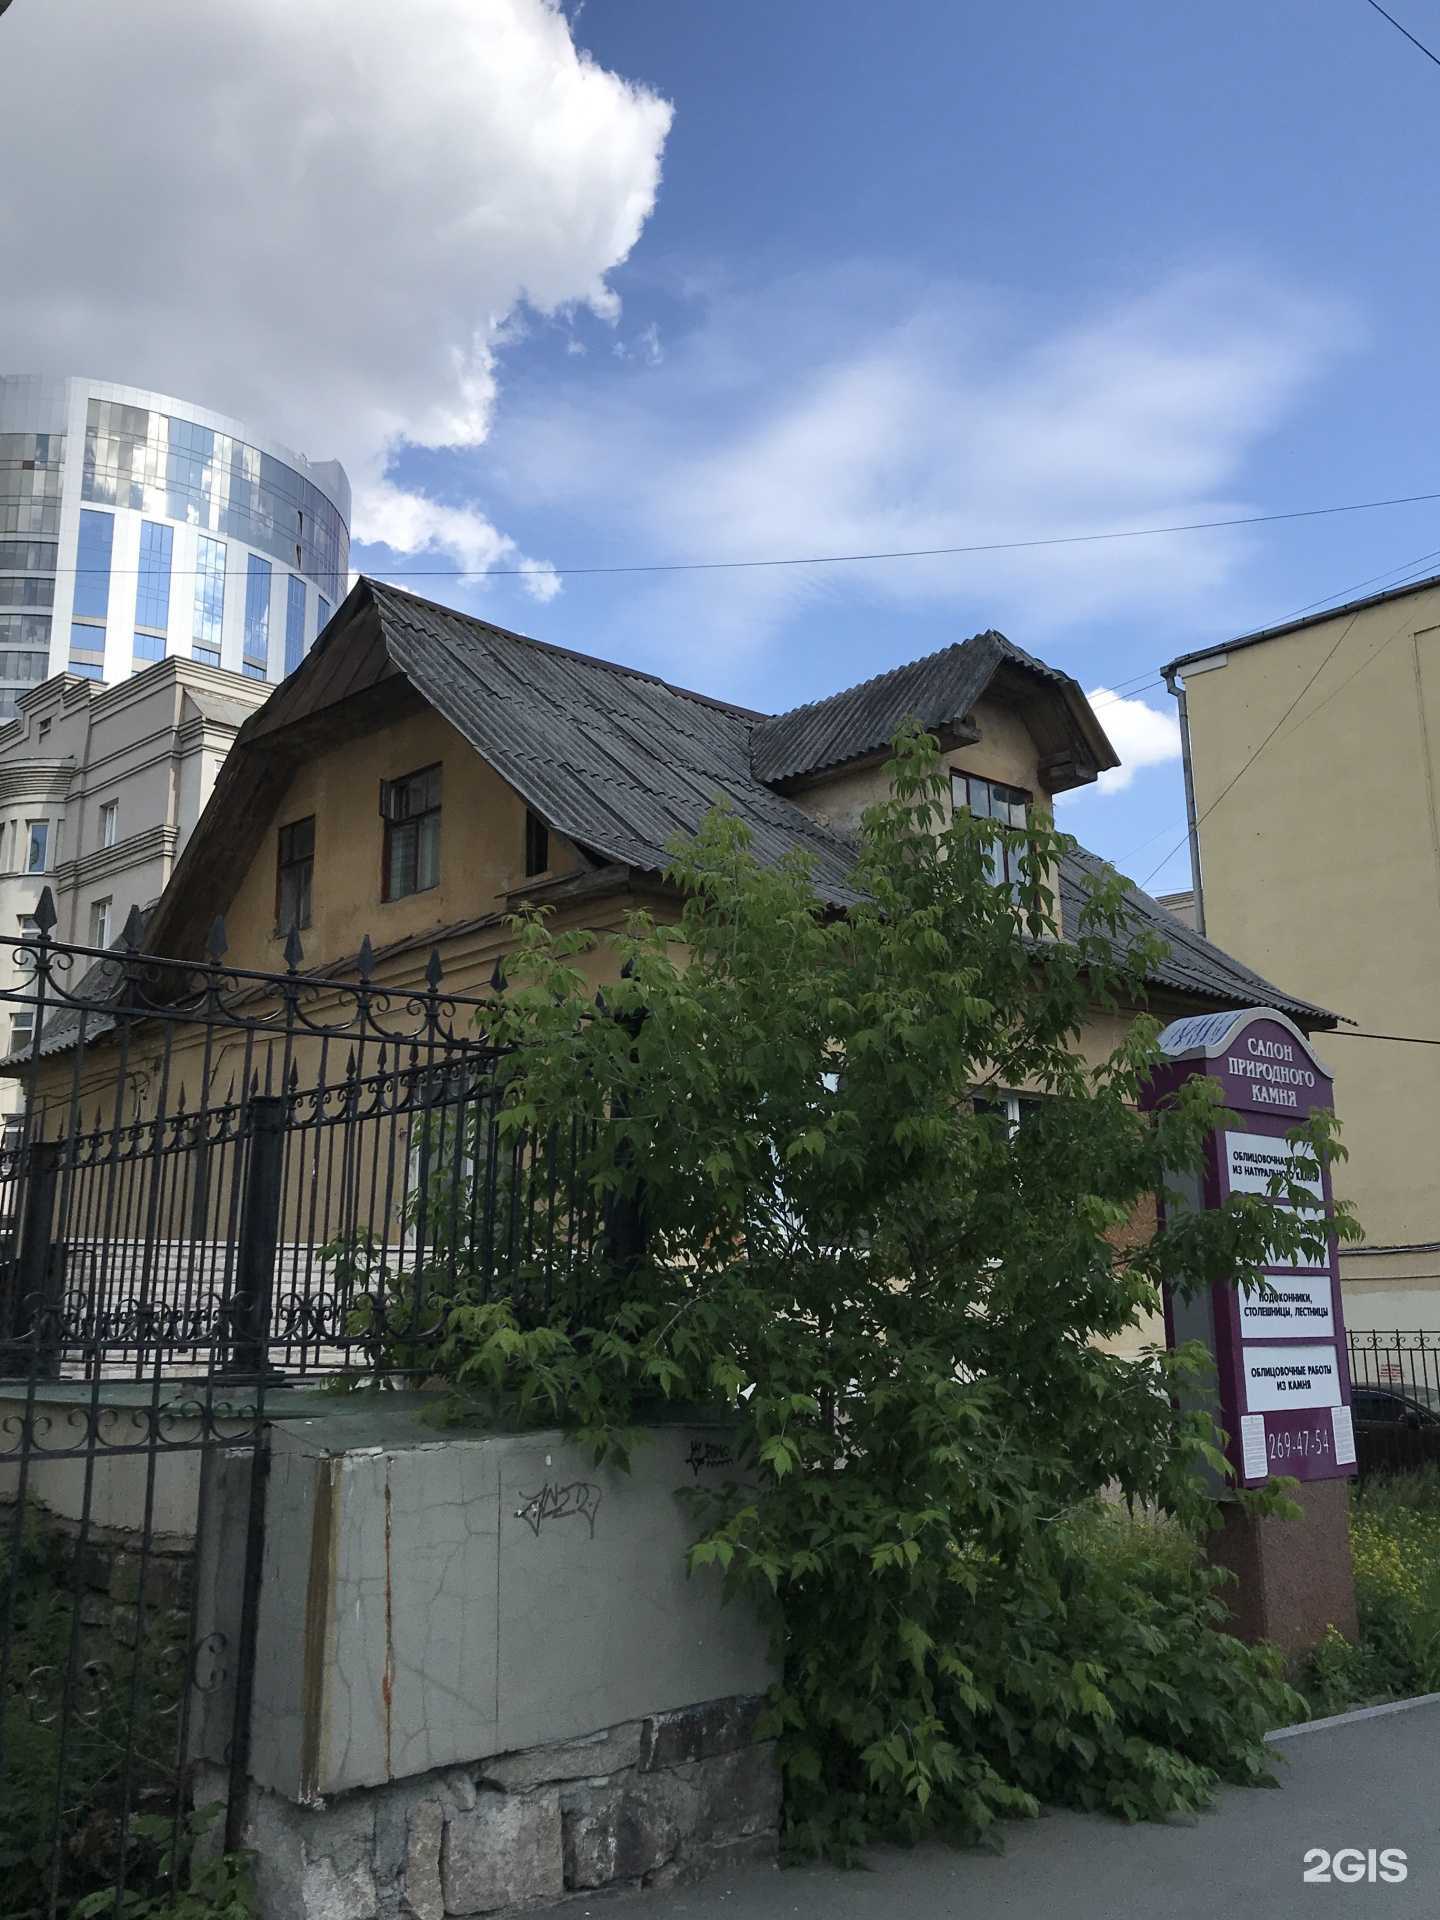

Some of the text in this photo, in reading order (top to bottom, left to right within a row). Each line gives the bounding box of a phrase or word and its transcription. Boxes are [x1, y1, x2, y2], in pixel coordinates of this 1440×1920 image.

[1247, 1038, 1293, 1062] САЛОН
[1228, 1057, 1315, 1088] ПРИРОДНОГО
[1252, 1085, 1297, 1107] КАМНЯ
[1233, 1151, 1287, 1166] ОБЛИЦОВОЧНА
[1233, 1165, 1242, 1175] ИЗ
[1244, 1306, 1329, 1318] СТОЛЕШНИЦЫ, ЛЕСТНИЦЫ
[1251, 1365, 1332, 1378] ОБЛИЦОВОЧНЫЕ РАБОТЫ
[1277, 1380, 1311, 1391] ИЗ КАМНЯ
[1269, 1429, 1329, 1459] 269-47-54
